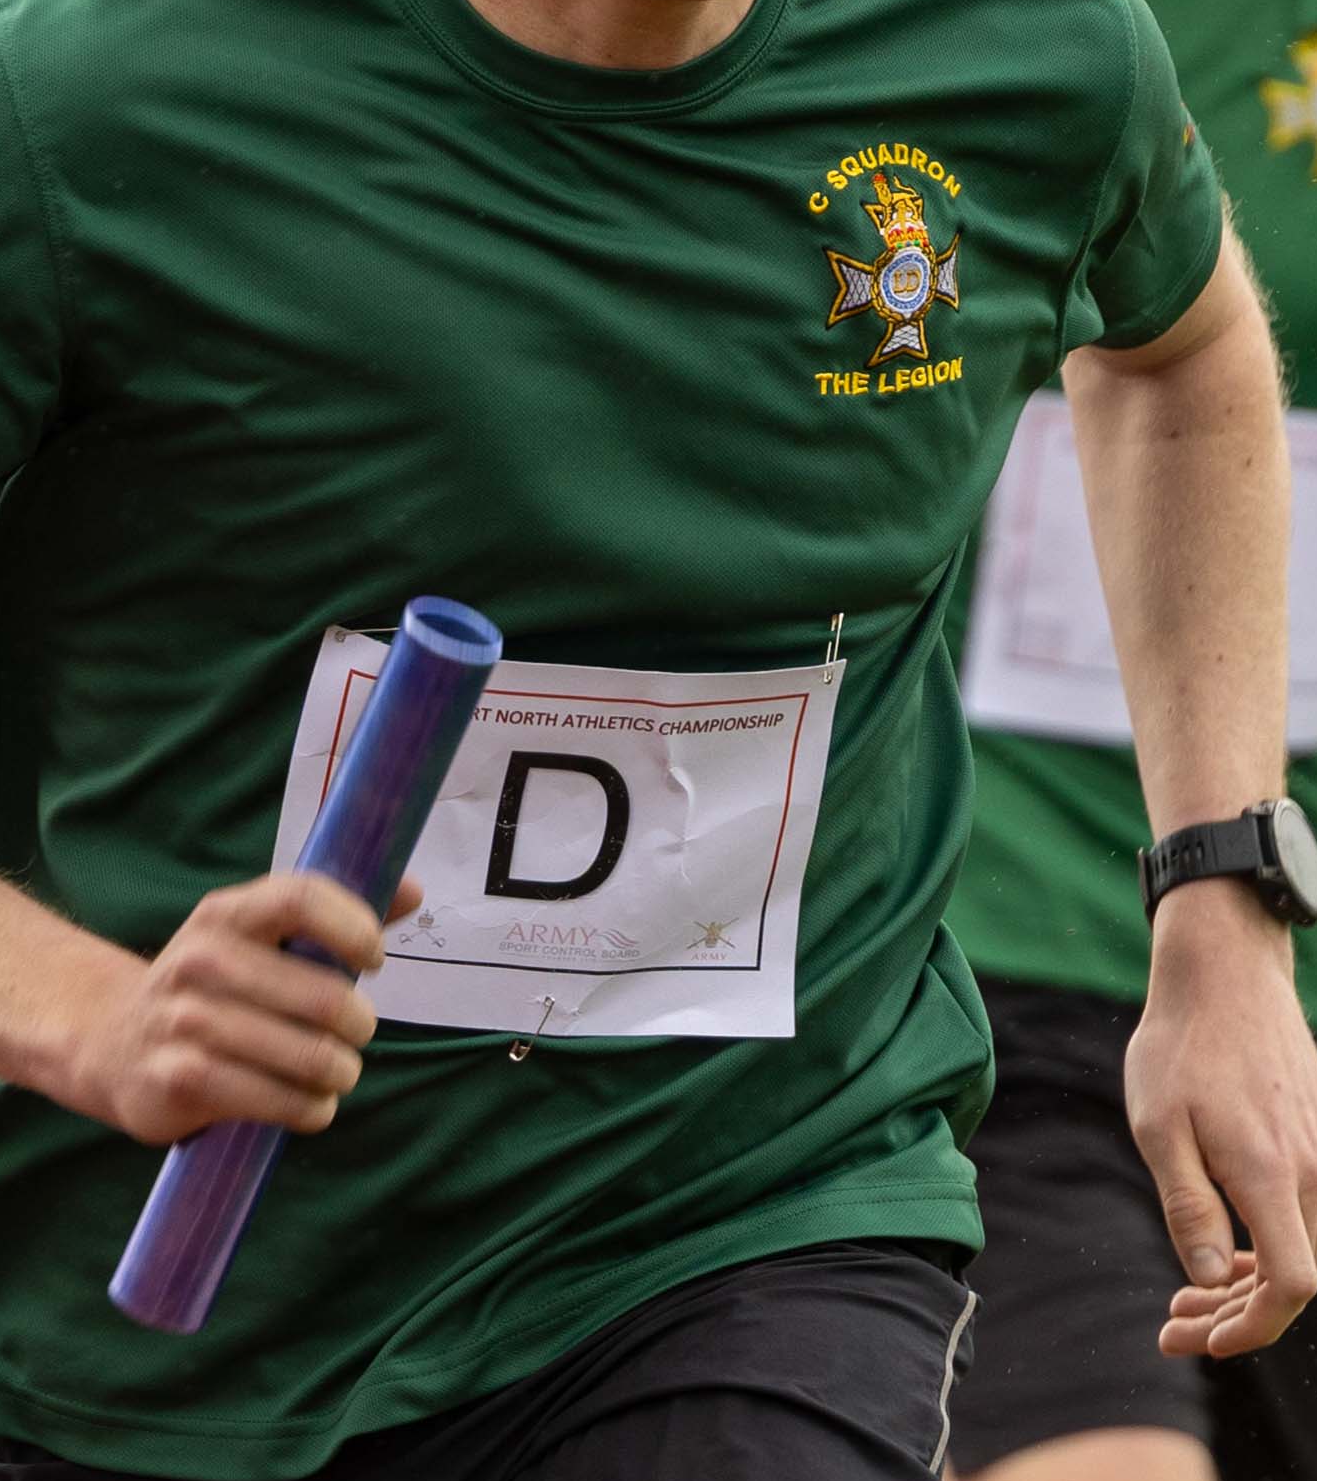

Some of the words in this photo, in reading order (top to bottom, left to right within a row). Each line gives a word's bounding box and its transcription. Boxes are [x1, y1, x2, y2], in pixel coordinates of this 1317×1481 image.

[809, 192, 829, 215] C
[826, 143, 962, 198] SQUADRON
[814, 372, 870, 395] THE
[878, 357, 964, 393] LEGION
[495, 709, 558, 727] NORTH
[561, 714, 655, 733] ATHLETICS
[658, 713, 784, 736] CHAMPIONSHIP
[484, 750, 630, 901] D
[498, 941, 538, 954] SPORT
[542, 945, 596, 958] CONTROL
[601, 948, 640, 959] BOARD
[506, 922, 598, 946] ARMY
